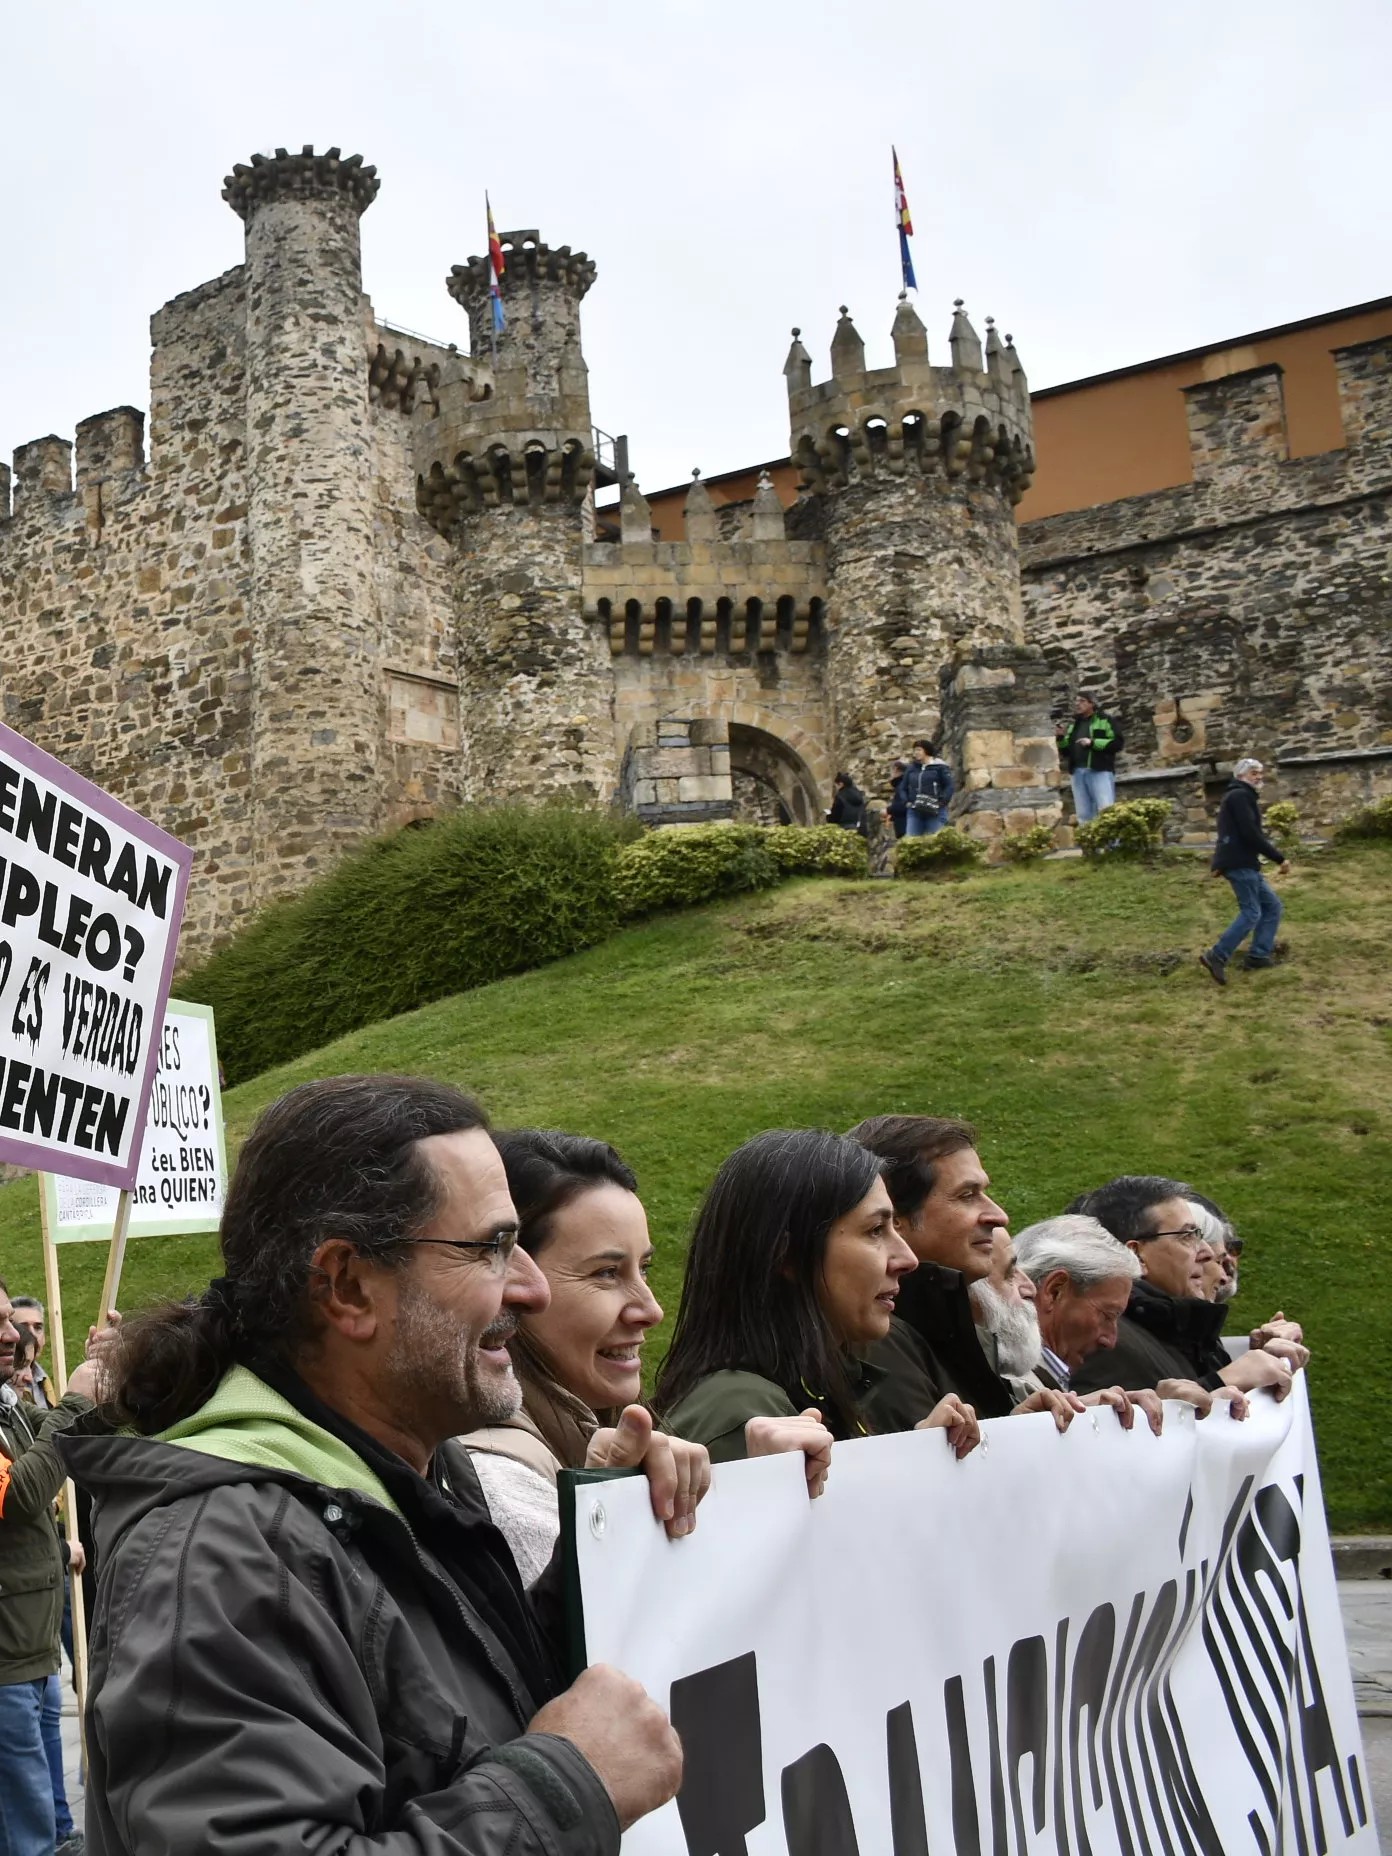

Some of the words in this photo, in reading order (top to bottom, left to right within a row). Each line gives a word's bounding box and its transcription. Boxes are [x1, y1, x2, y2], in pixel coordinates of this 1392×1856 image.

[11, 956, 50, 1057] ES
[62, 973, 143, 1078] VERDAD
[148, 1067, 211, 1141] ÚBLICO?
[180, 1147, 215, 1172] BIEN
[161, 1178, 216, 1209] QUIEN?
